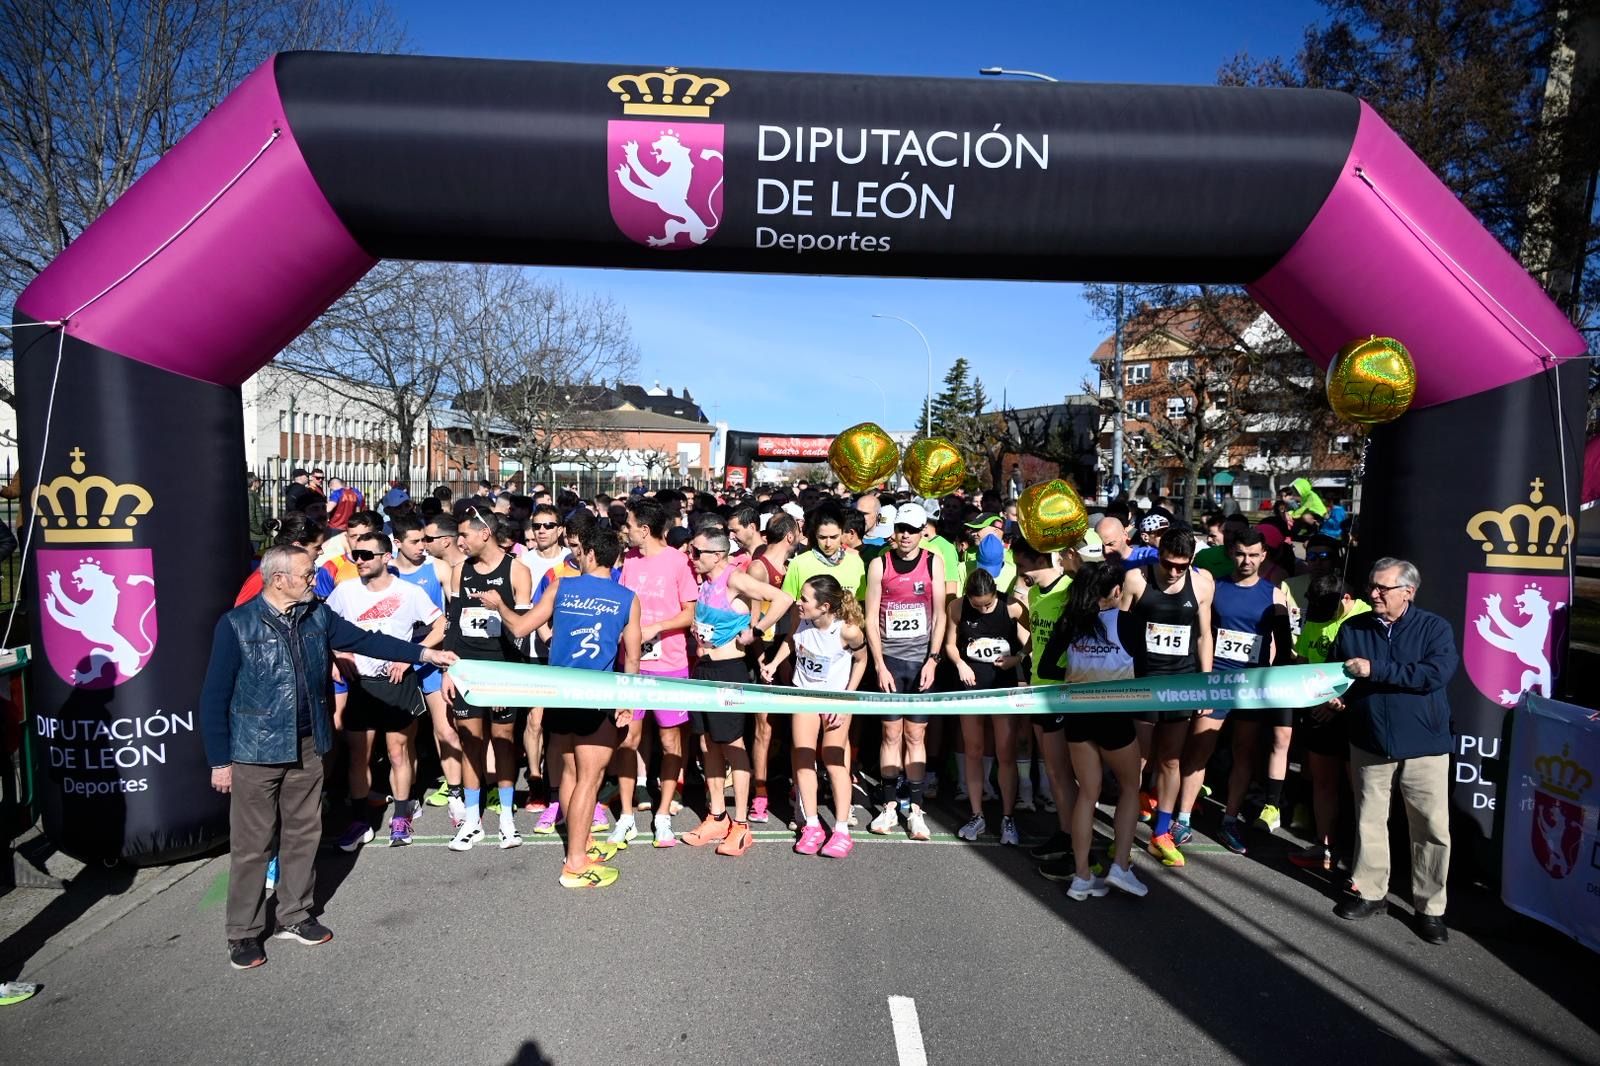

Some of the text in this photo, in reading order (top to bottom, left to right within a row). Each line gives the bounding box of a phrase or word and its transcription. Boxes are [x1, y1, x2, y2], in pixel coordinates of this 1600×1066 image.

[757, 123, 1049, 169] DIPUTACIÓN
[757, 171, 955, 220] DE LEÓN
[756, 227, 891, 253] Deportes
[560, 598, 620, 616] intelligent
[892, 619, 919, 631] 223
[1153, 634, 1181, 648] 115
[1223, 640, 1251, 654] 376
[974, 647, 1001, 658] 105
[801, 657, 822, 673] 132
[1207, 674, 1220, 685] 10
[1209, 688, 1235, 700] DEL
[37, 710, 194, 741] DIPUTACIÓN
[50, 741, 167, 769] DE LEÓN
[63, 776, 148, 797] Deportes
